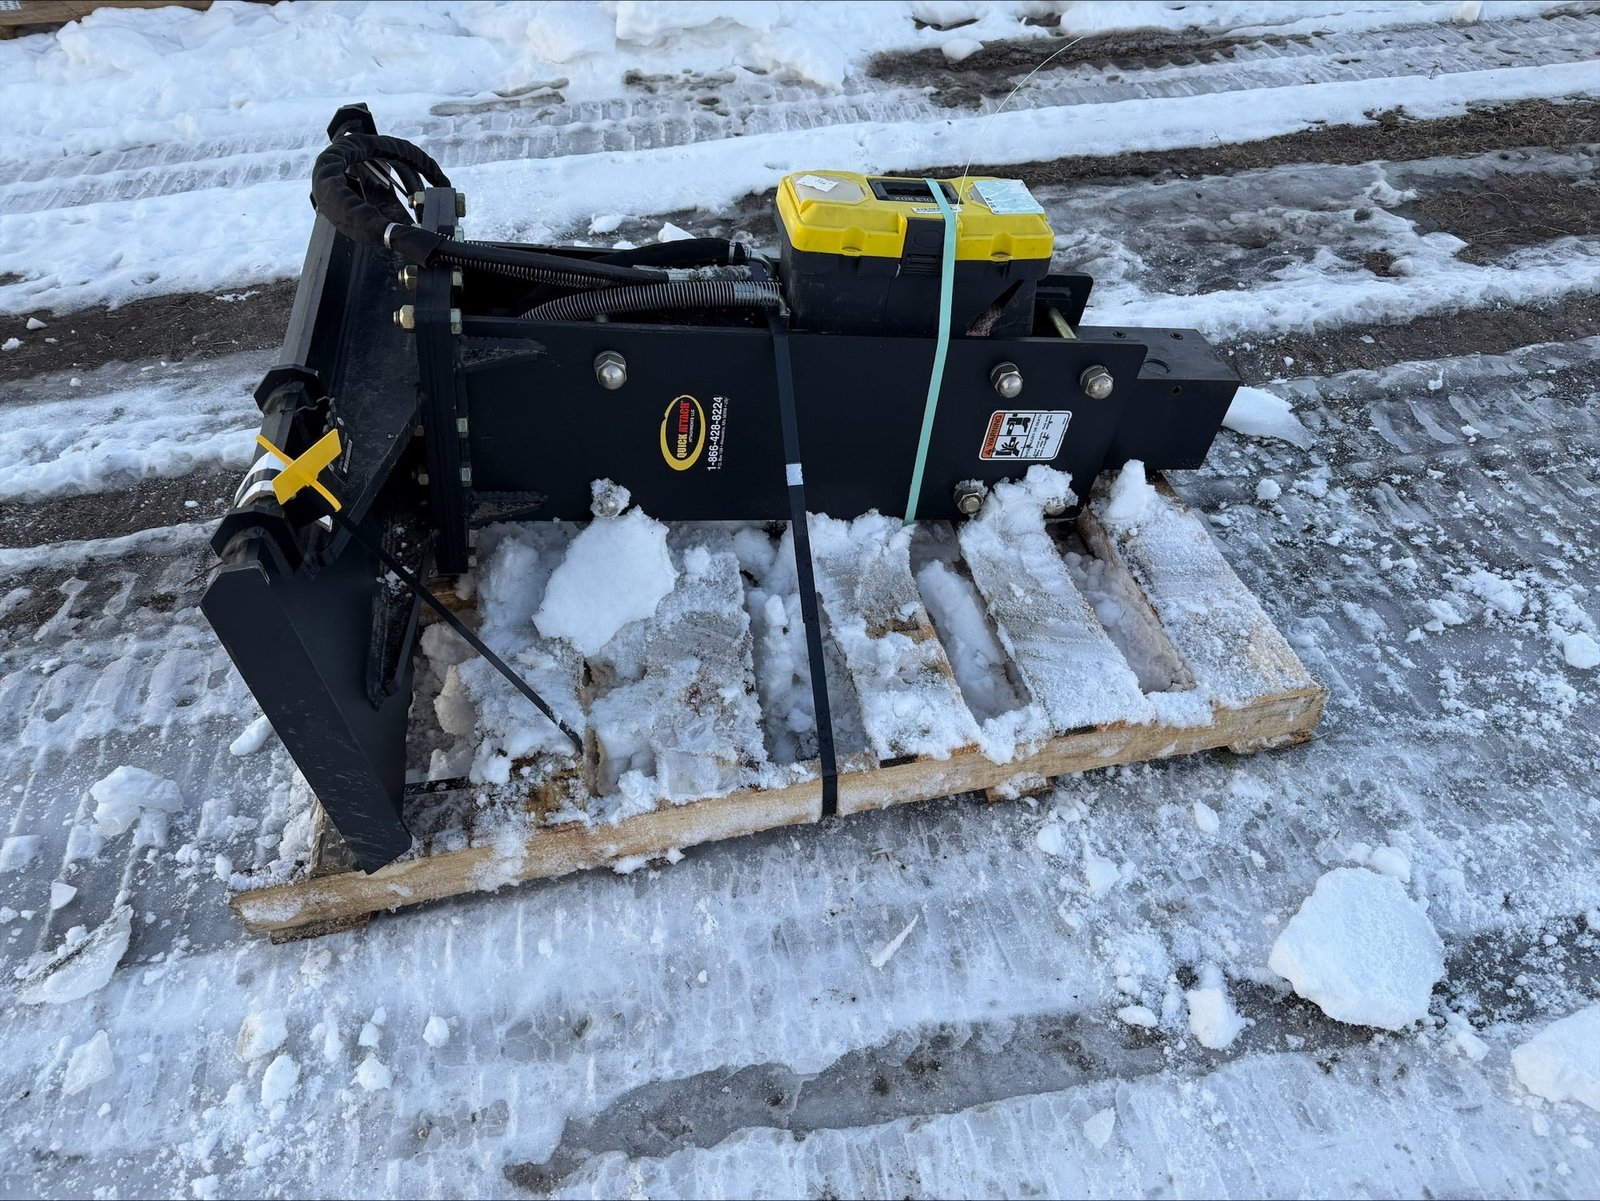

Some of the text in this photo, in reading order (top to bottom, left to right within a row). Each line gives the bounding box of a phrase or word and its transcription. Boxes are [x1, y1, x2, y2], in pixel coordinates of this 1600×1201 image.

[677, 403, 690, 458] QUICK ATTACH
[707, 396, 723, 471] 1-866-428-8224
[988, 415, 1002, 447] WARNING
